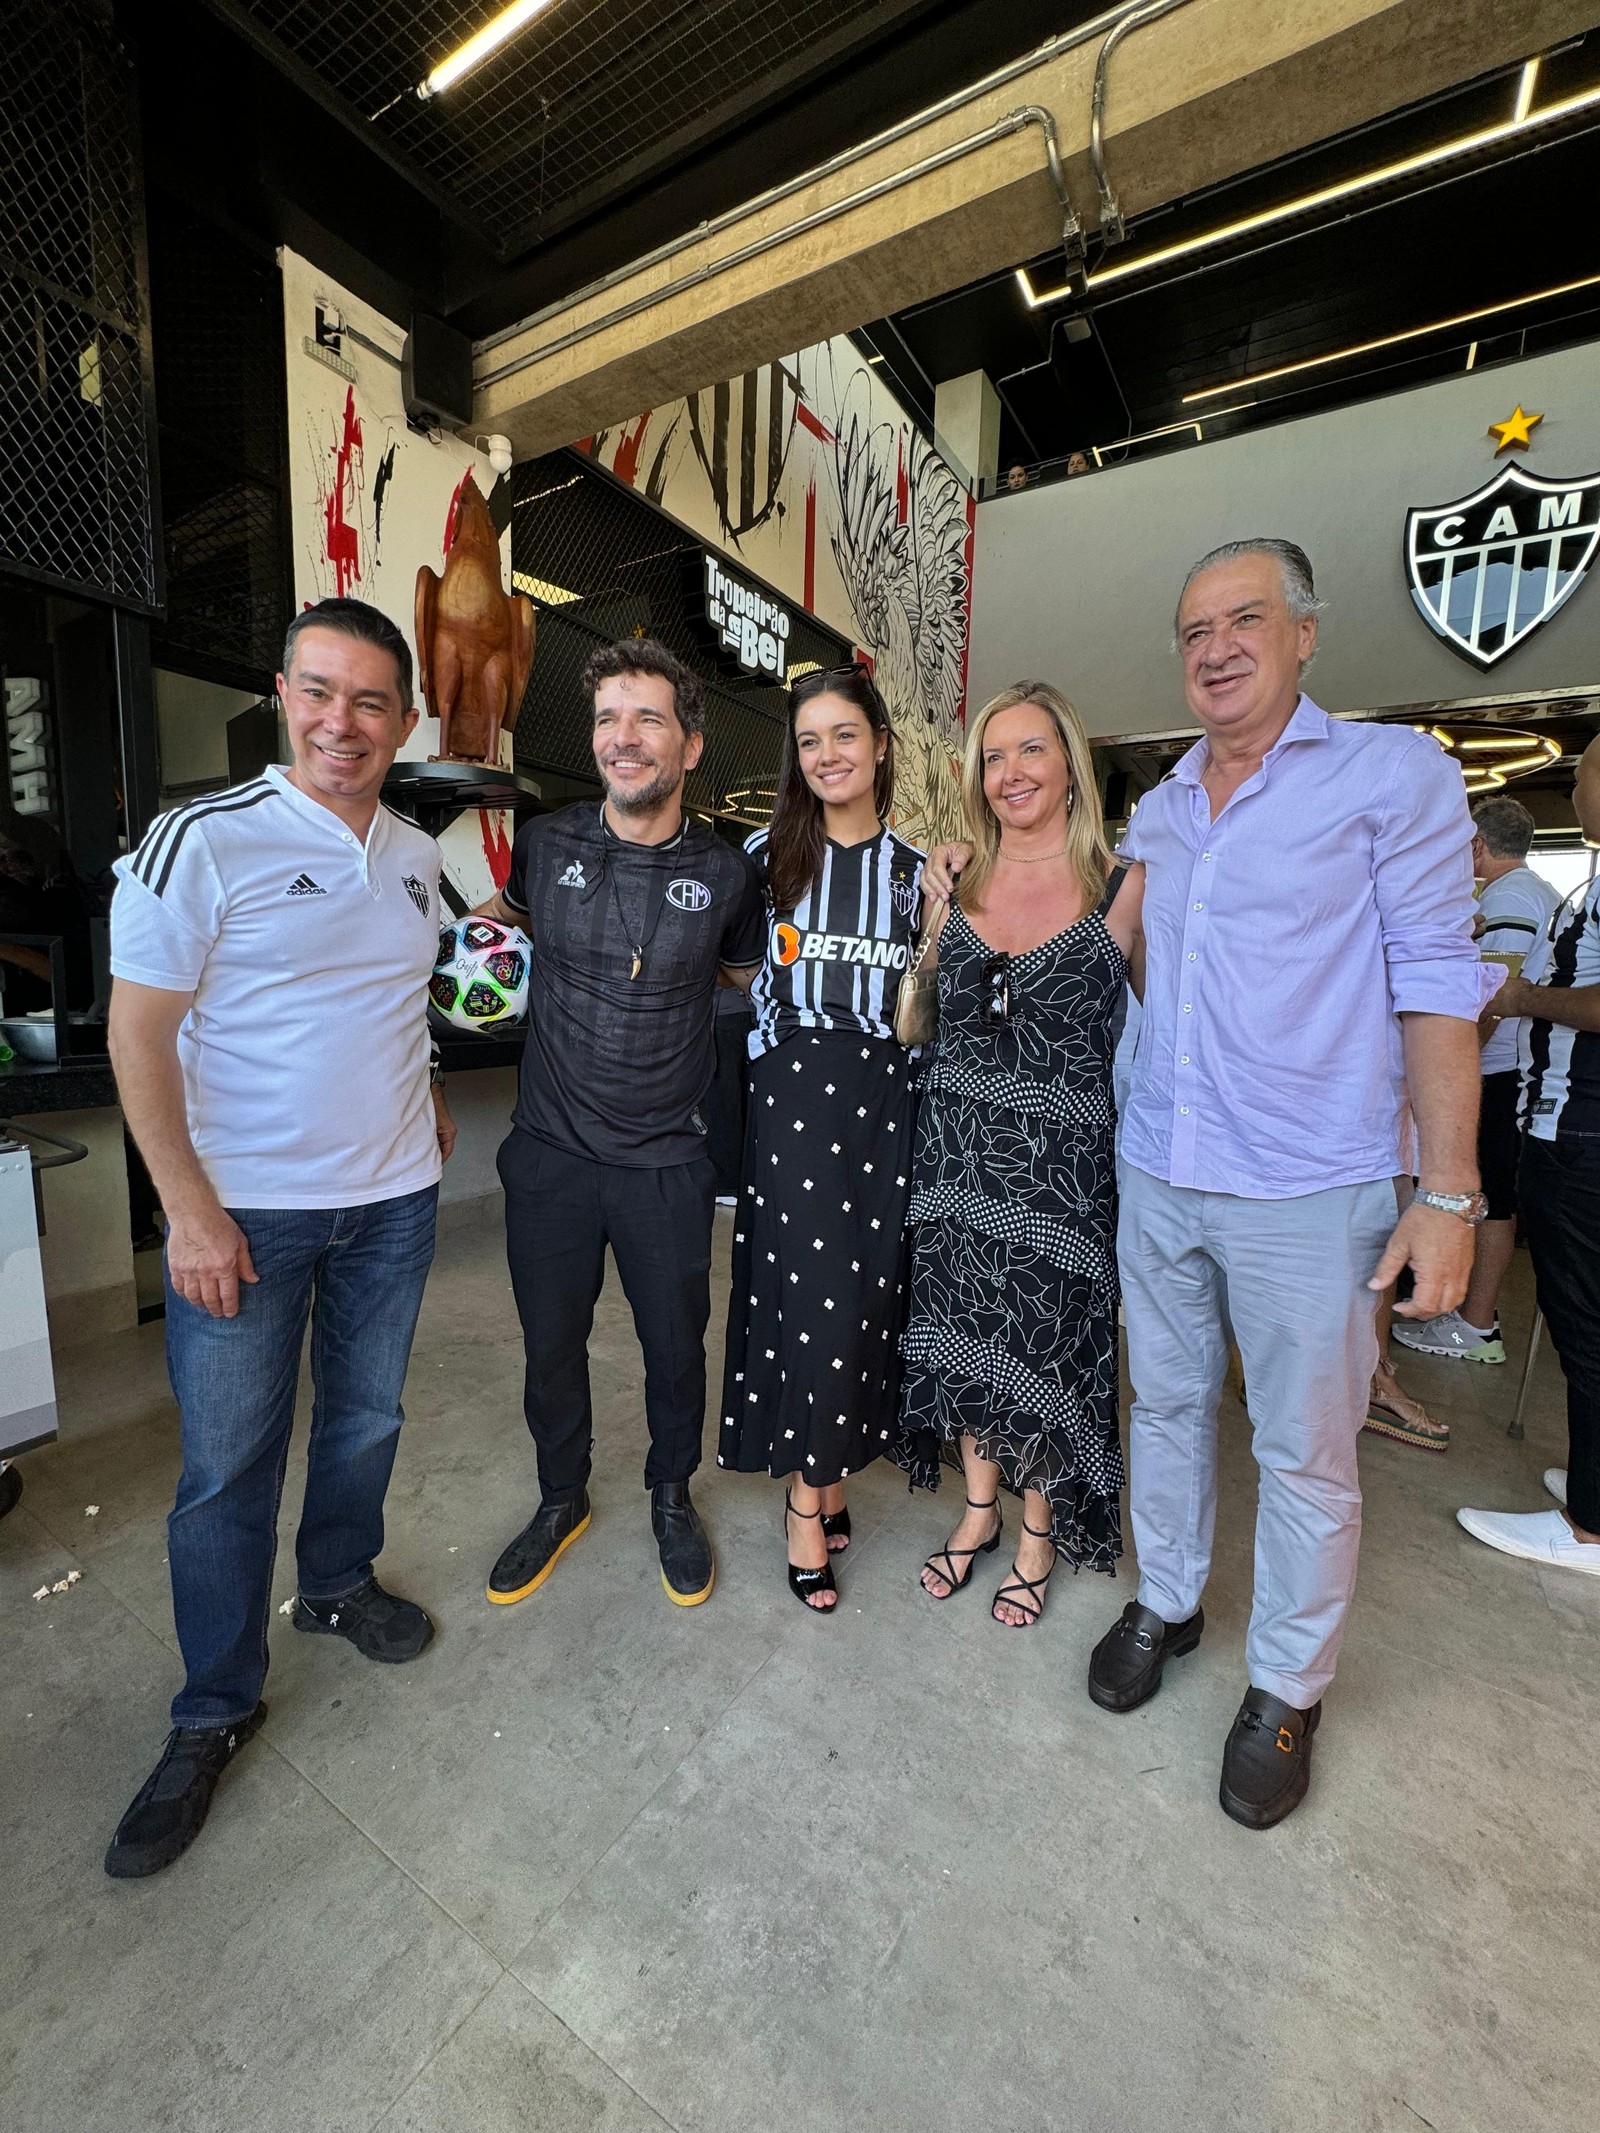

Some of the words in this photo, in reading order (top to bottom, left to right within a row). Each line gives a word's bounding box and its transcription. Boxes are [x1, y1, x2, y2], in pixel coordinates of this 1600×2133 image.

[1433, 491, 1583, 547] CAM
[705, 554, 790, 639] Tropeirão
[709, 599, 726, 627] da
[722, 613, 742, 649] Tia
[740, 615, 785, 679] Bel
[286, 886, 328, 897] adidas
[668, 881, 710, 910] CAM
[801, 933, 908, 970] BETANO
